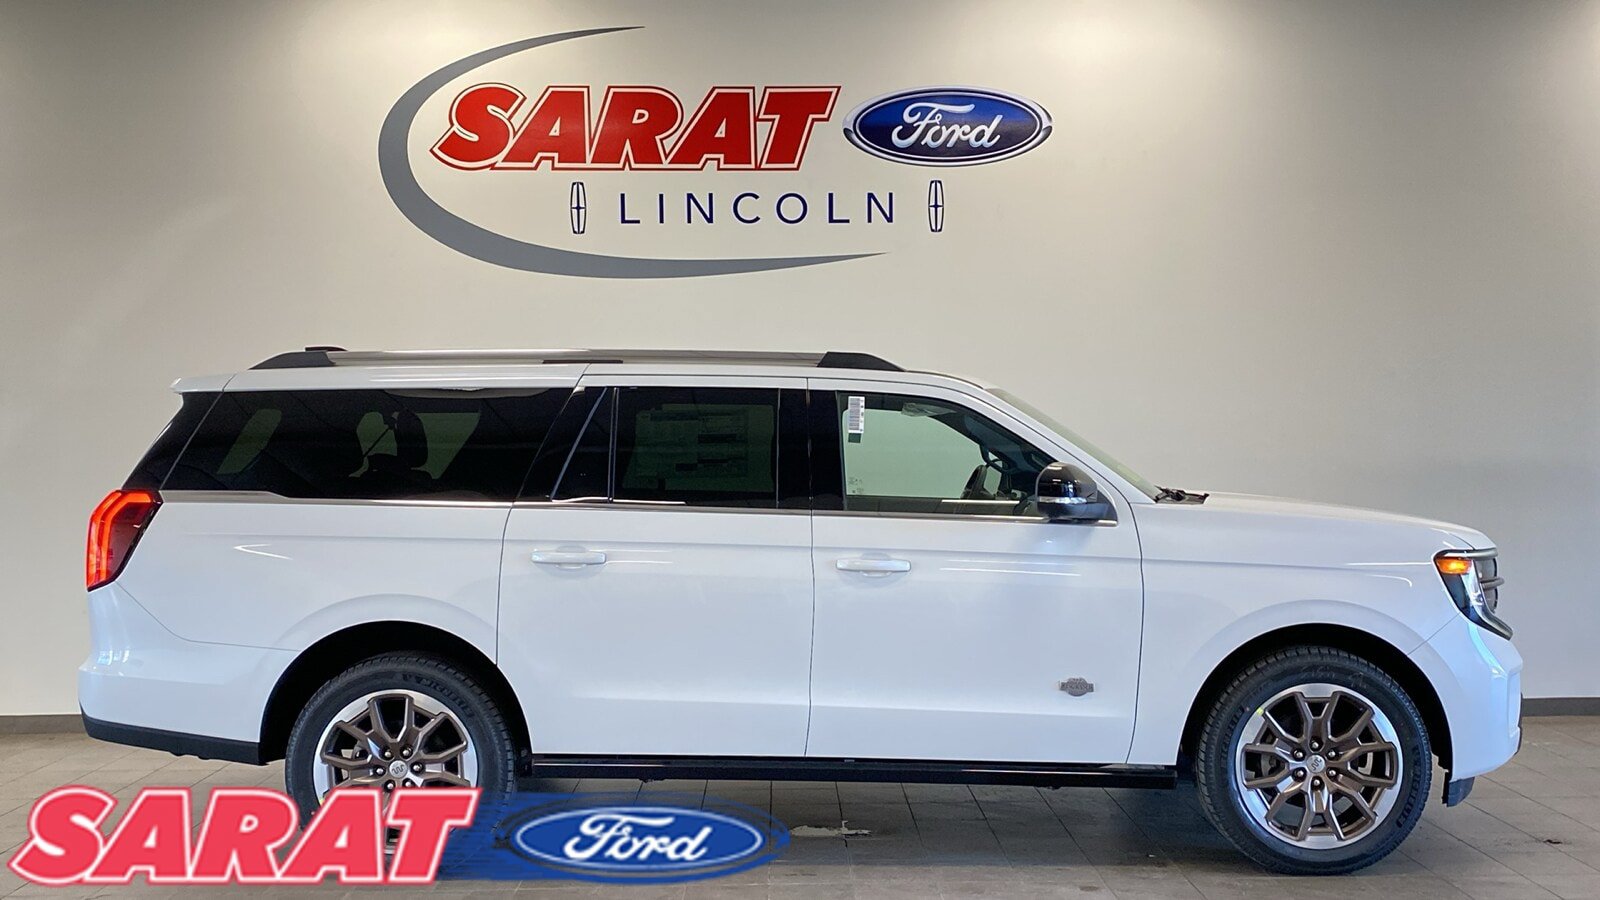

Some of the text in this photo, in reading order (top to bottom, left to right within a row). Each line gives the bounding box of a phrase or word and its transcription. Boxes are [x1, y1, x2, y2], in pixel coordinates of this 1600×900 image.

[430, 83, 1002, 171] SARAT Ford
[619, 192, 895, 225] LINCOLN
